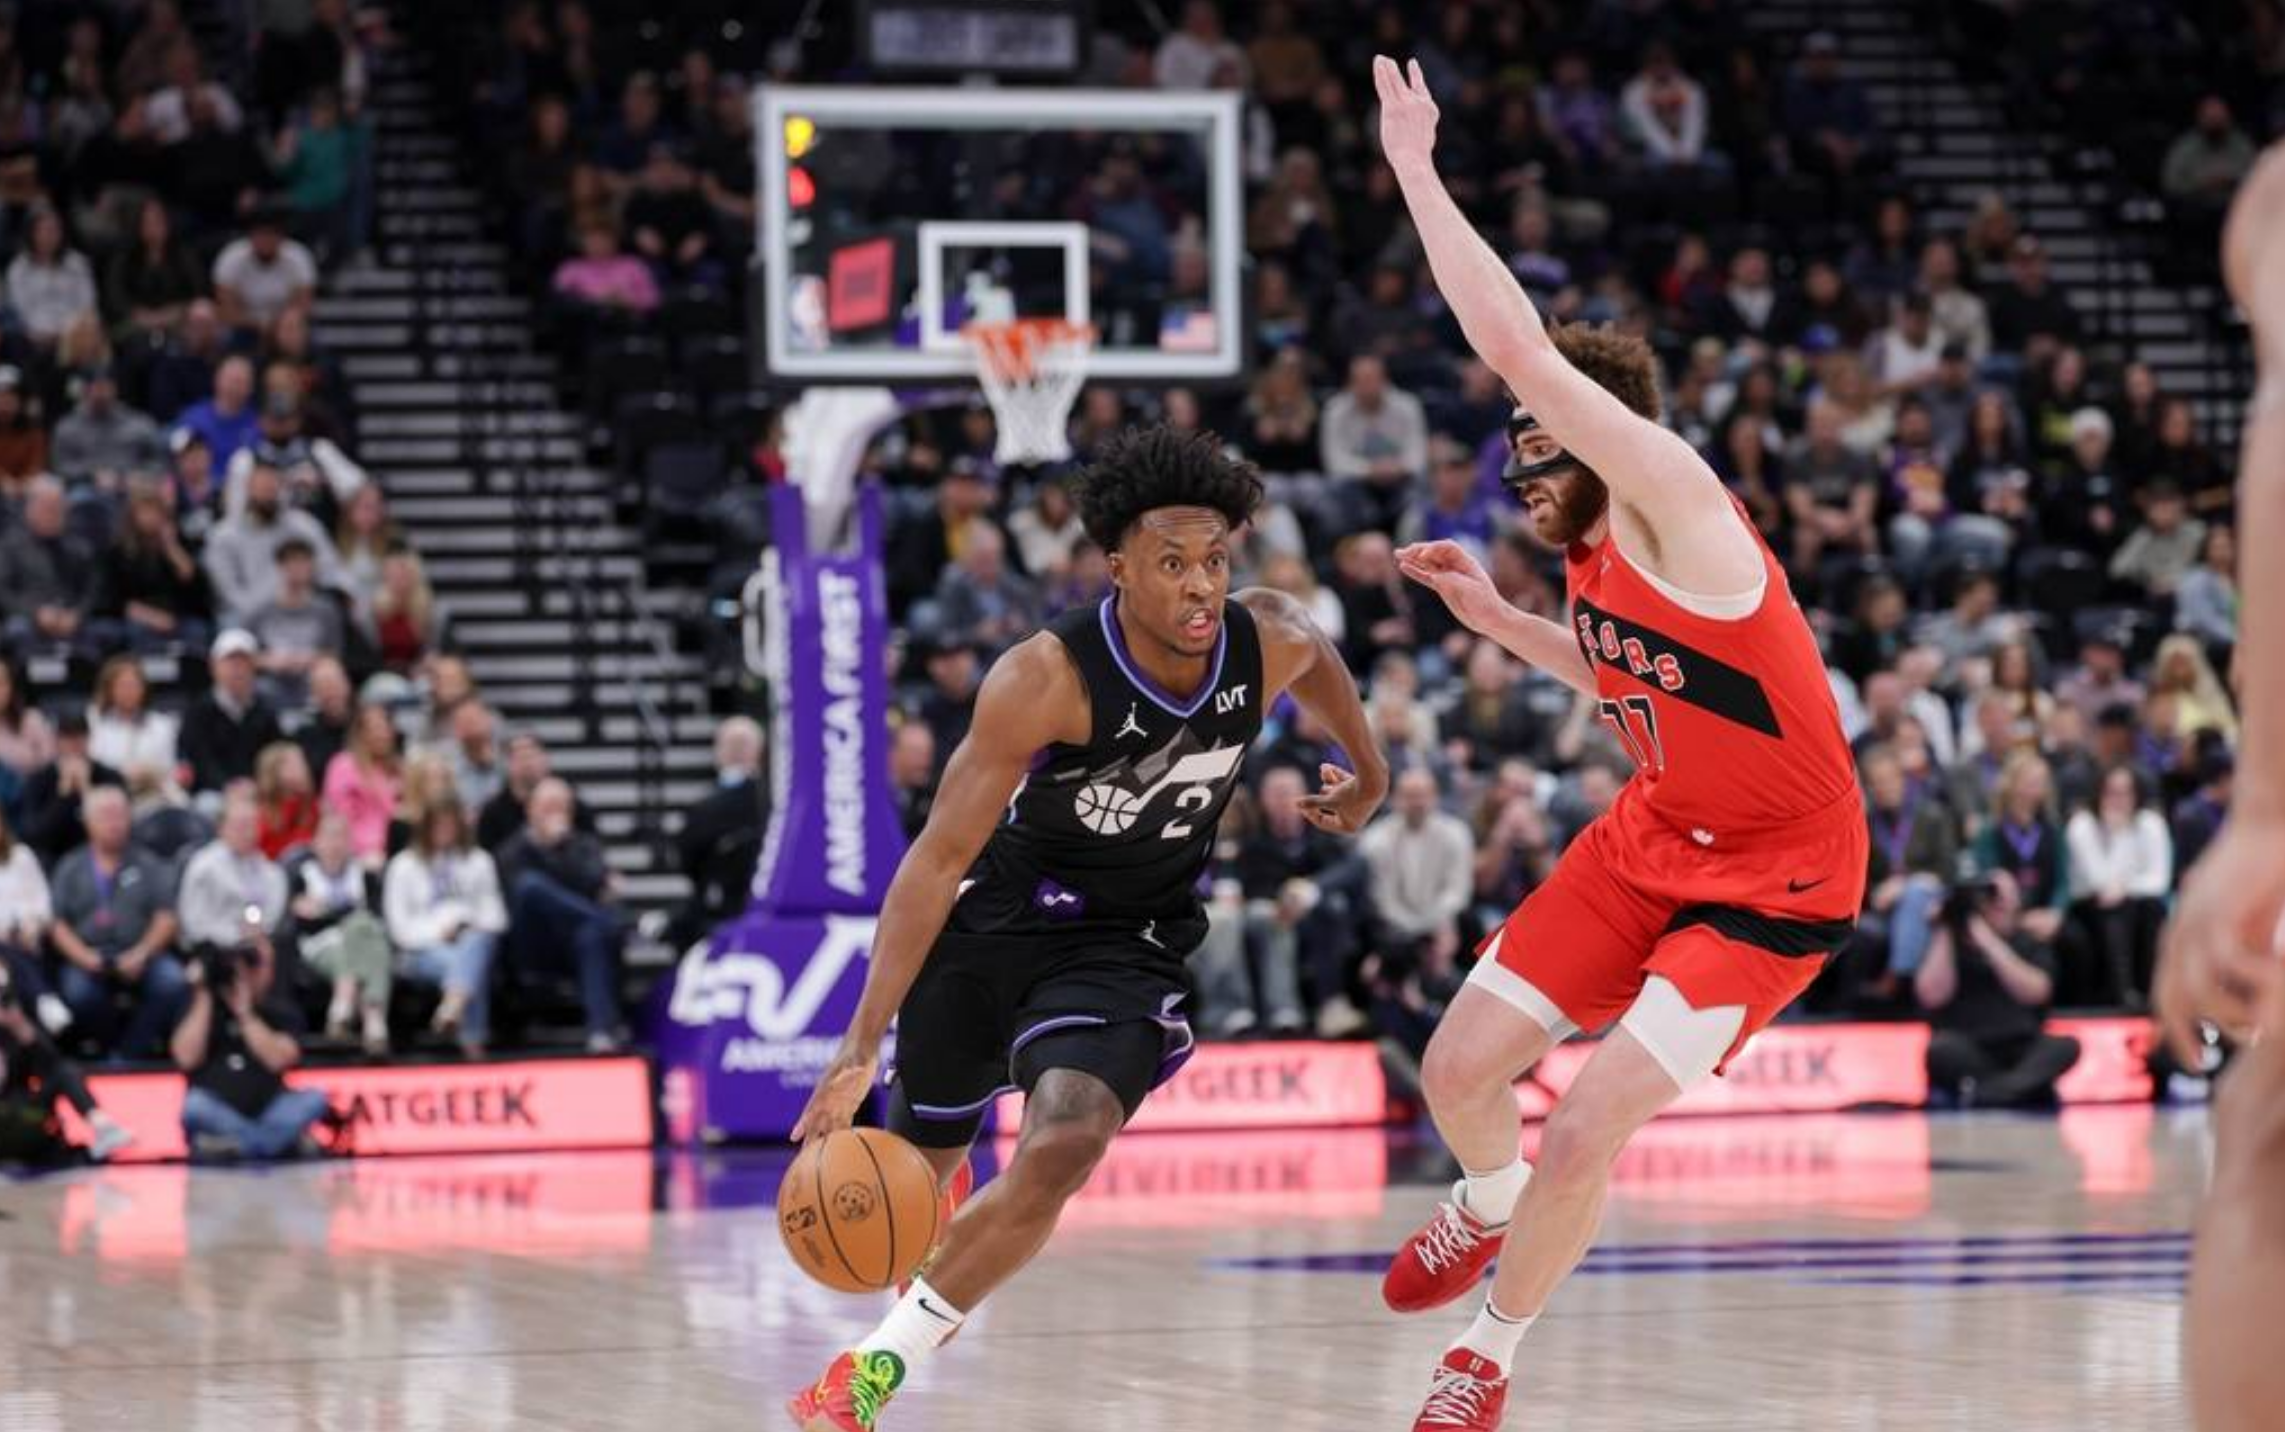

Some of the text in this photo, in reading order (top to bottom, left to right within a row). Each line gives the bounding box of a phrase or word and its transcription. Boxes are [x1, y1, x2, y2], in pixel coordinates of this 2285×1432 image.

[1216, 684, 1248, 714] LVT
[819, 567, 866, 897] AMERICA FIRST
[1600, 694, 1664, 771] 77
[1160, 785, 1213, 839] 2
[346, 1083, 538, 1128] ATGEEK
